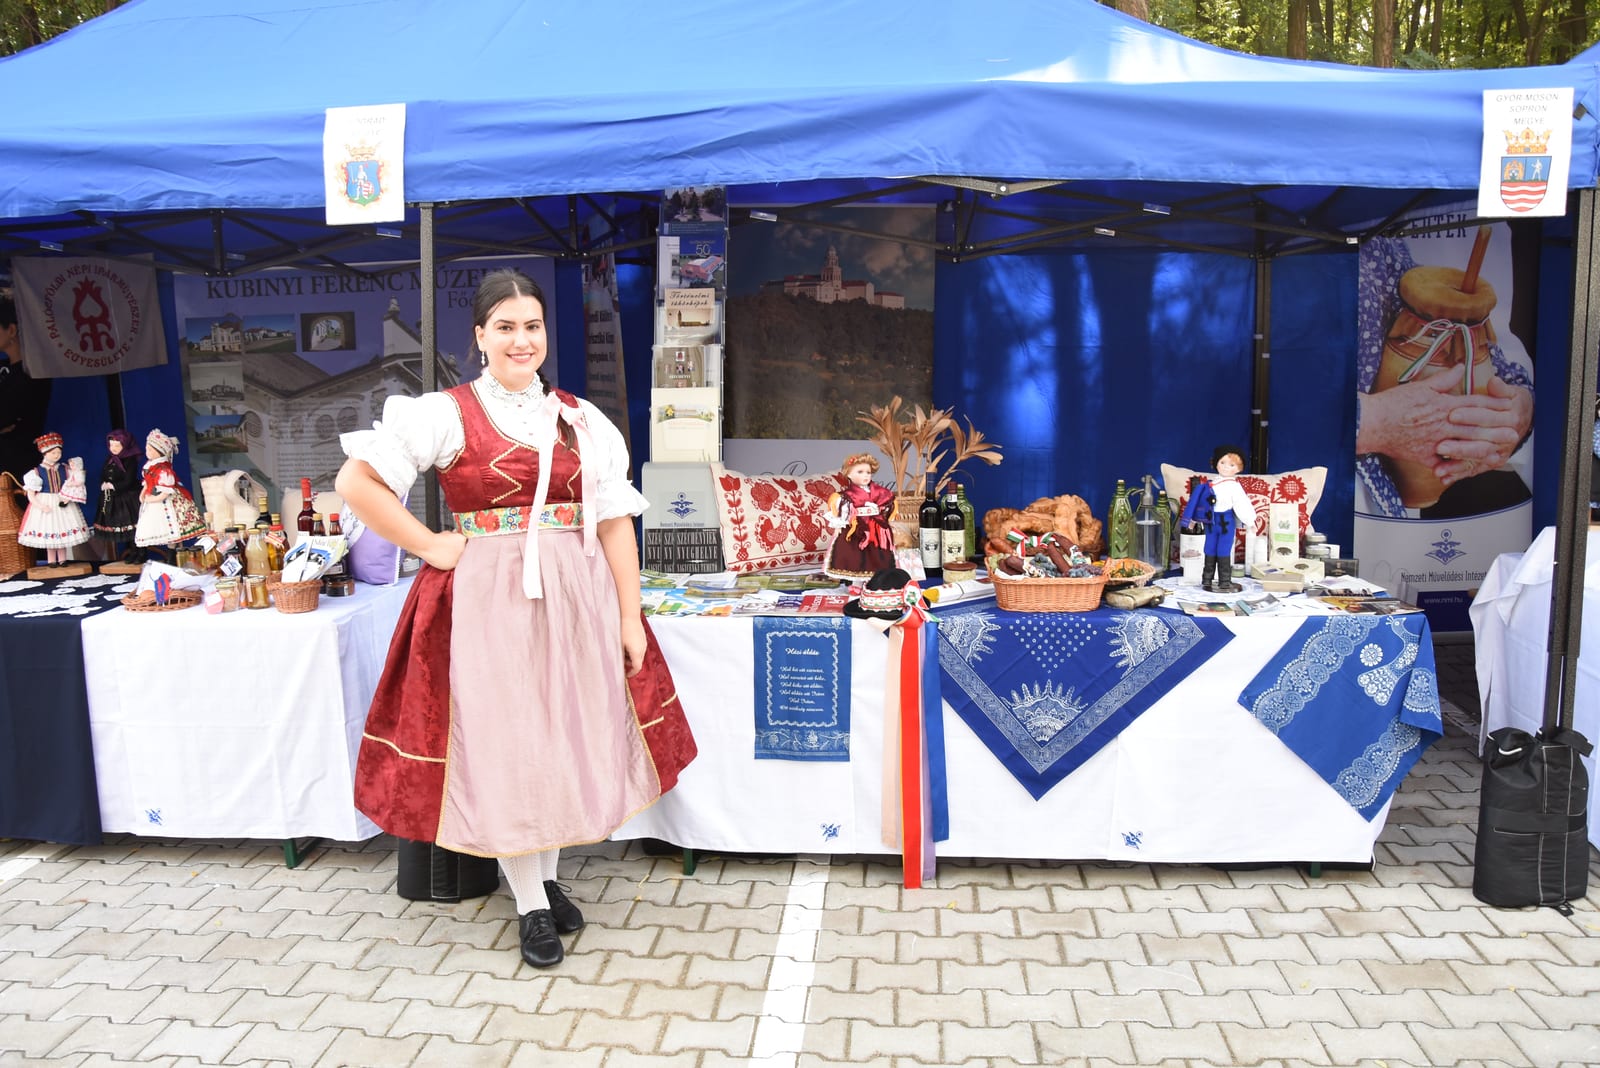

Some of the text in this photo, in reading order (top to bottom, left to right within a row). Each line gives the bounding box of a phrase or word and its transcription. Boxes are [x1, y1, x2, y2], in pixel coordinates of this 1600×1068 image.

[1509, 105, 1547, 113] SOPRON
[67, 264, 92, 278] NÉPI
[206, 276, 304, 299] KUBINYI
[311, 272, 404, 294] FERENC
[64, 342, 130, 368] EGYESÜLETE
[1401, 571, 1426, 584] Nemzeti
